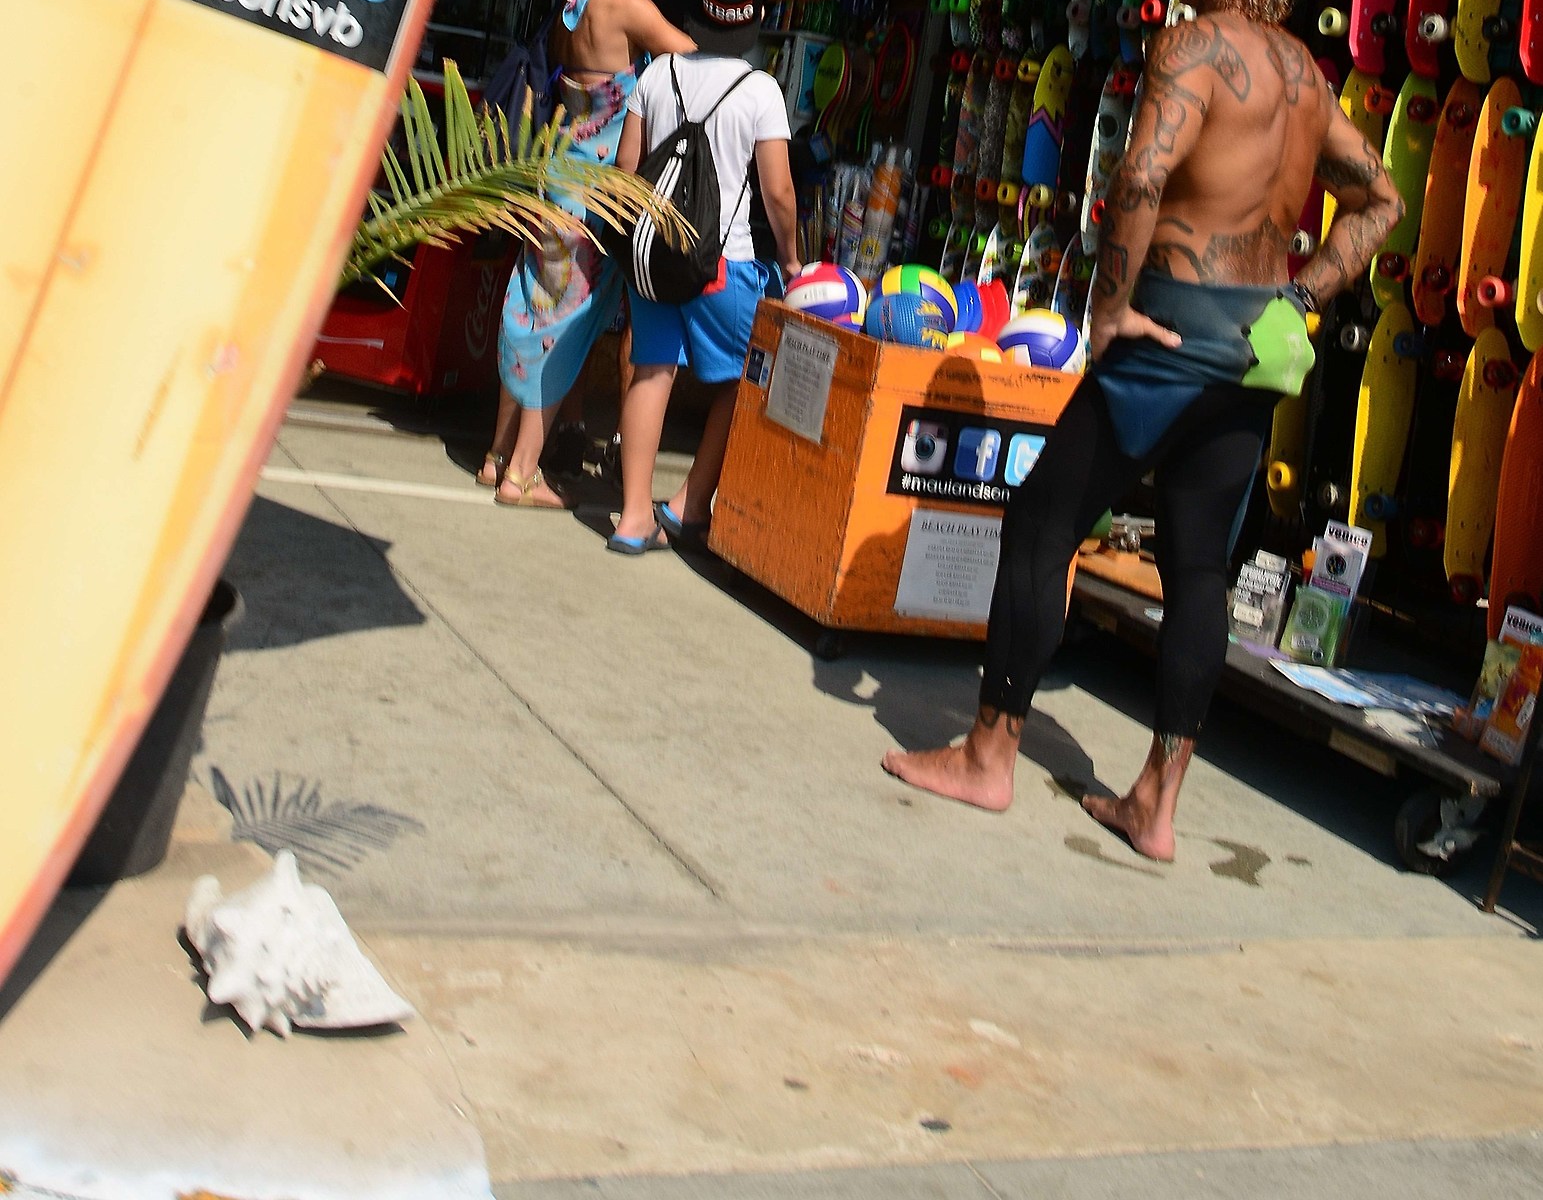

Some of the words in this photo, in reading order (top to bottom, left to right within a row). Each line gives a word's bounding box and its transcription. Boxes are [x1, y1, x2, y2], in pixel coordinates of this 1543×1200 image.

[901, 472, 1010, 502] #mauiandson
[921, 519, 956, 535] BEACH
[957, 524, 982, 537] PLAY
[984, 527, 1001, 539] TIM
